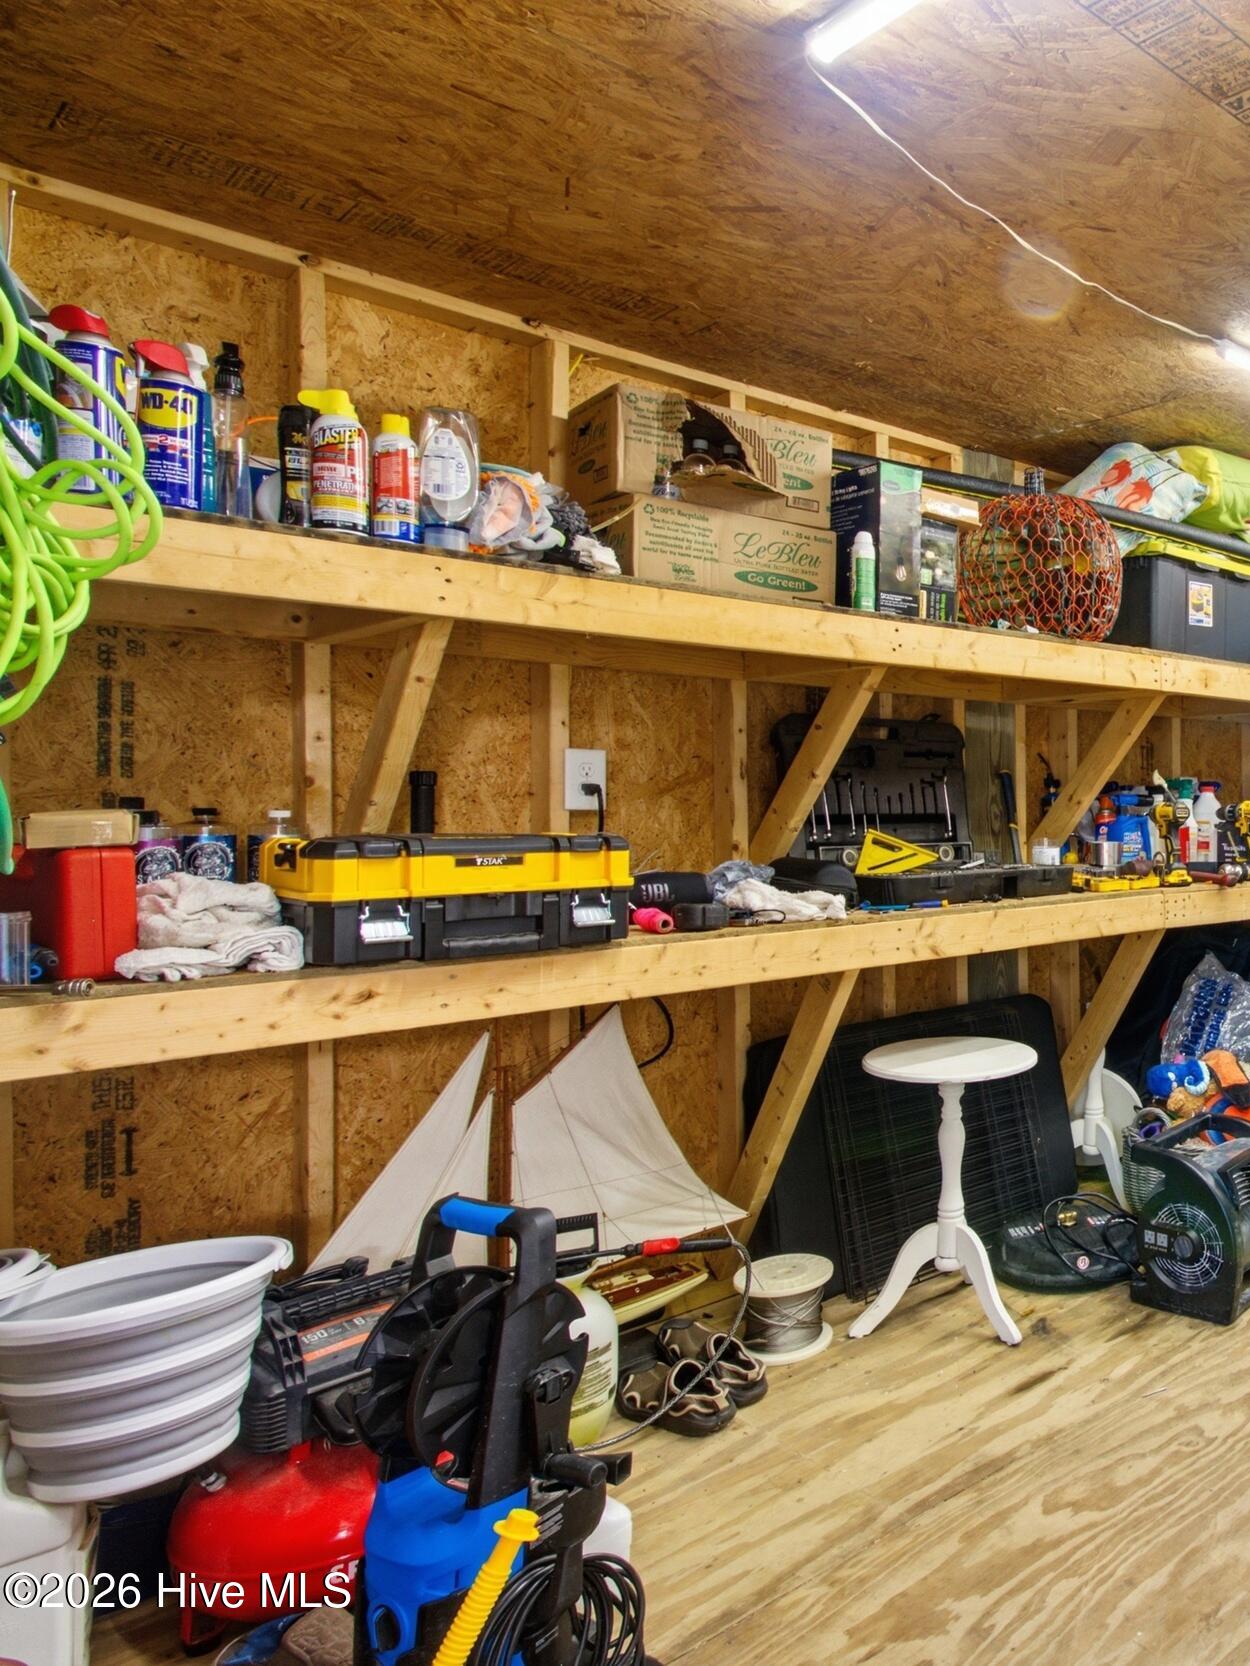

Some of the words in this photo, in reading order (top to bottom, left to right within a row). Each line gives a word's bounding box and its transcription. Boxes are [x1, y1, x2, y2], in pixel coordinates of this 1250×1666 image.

[140, 391, 194, 414] WD-40
[747, 572, 765, 584] Go
[767, 575, 807, 591] Green!
[640, 883, 675, 902] JBL
[301, 1328, 329, 1344] 150
